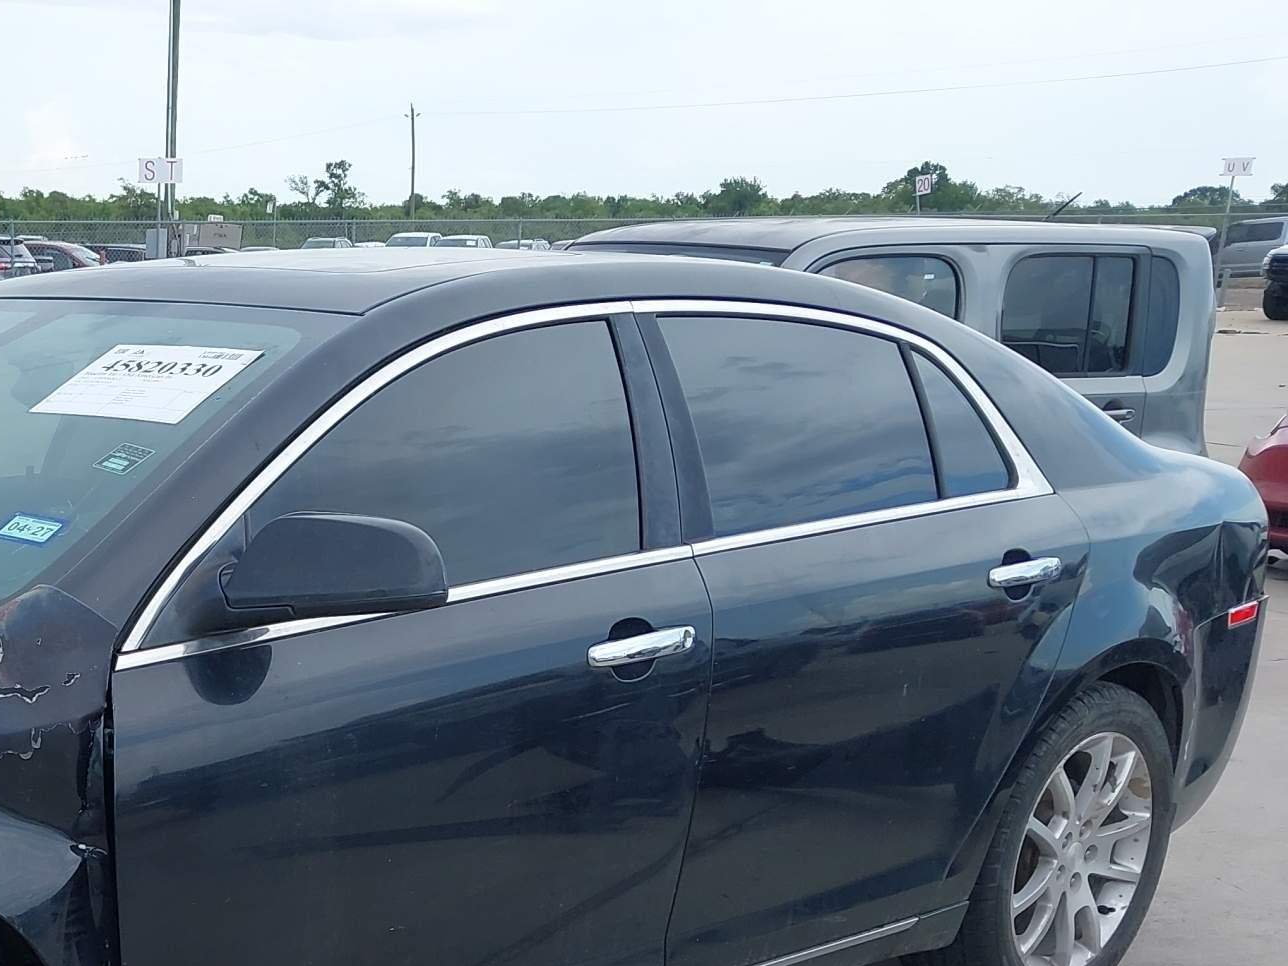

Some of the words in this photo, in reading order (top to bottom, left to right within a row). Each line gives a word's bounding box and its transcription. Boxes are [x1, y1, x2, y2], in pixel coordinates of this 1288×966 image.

[144, 160, 156, 181] S
[166, 160, 177, 181] T
[1227, 161, 1235, 173] U
[1242, 161, 1250, 172] V
[917, 177, 930, 193] 20
[102, 359, 223, 378] 45820330
[7, 521, 25, 534] 04
[31, 526, 53, 538] 27
